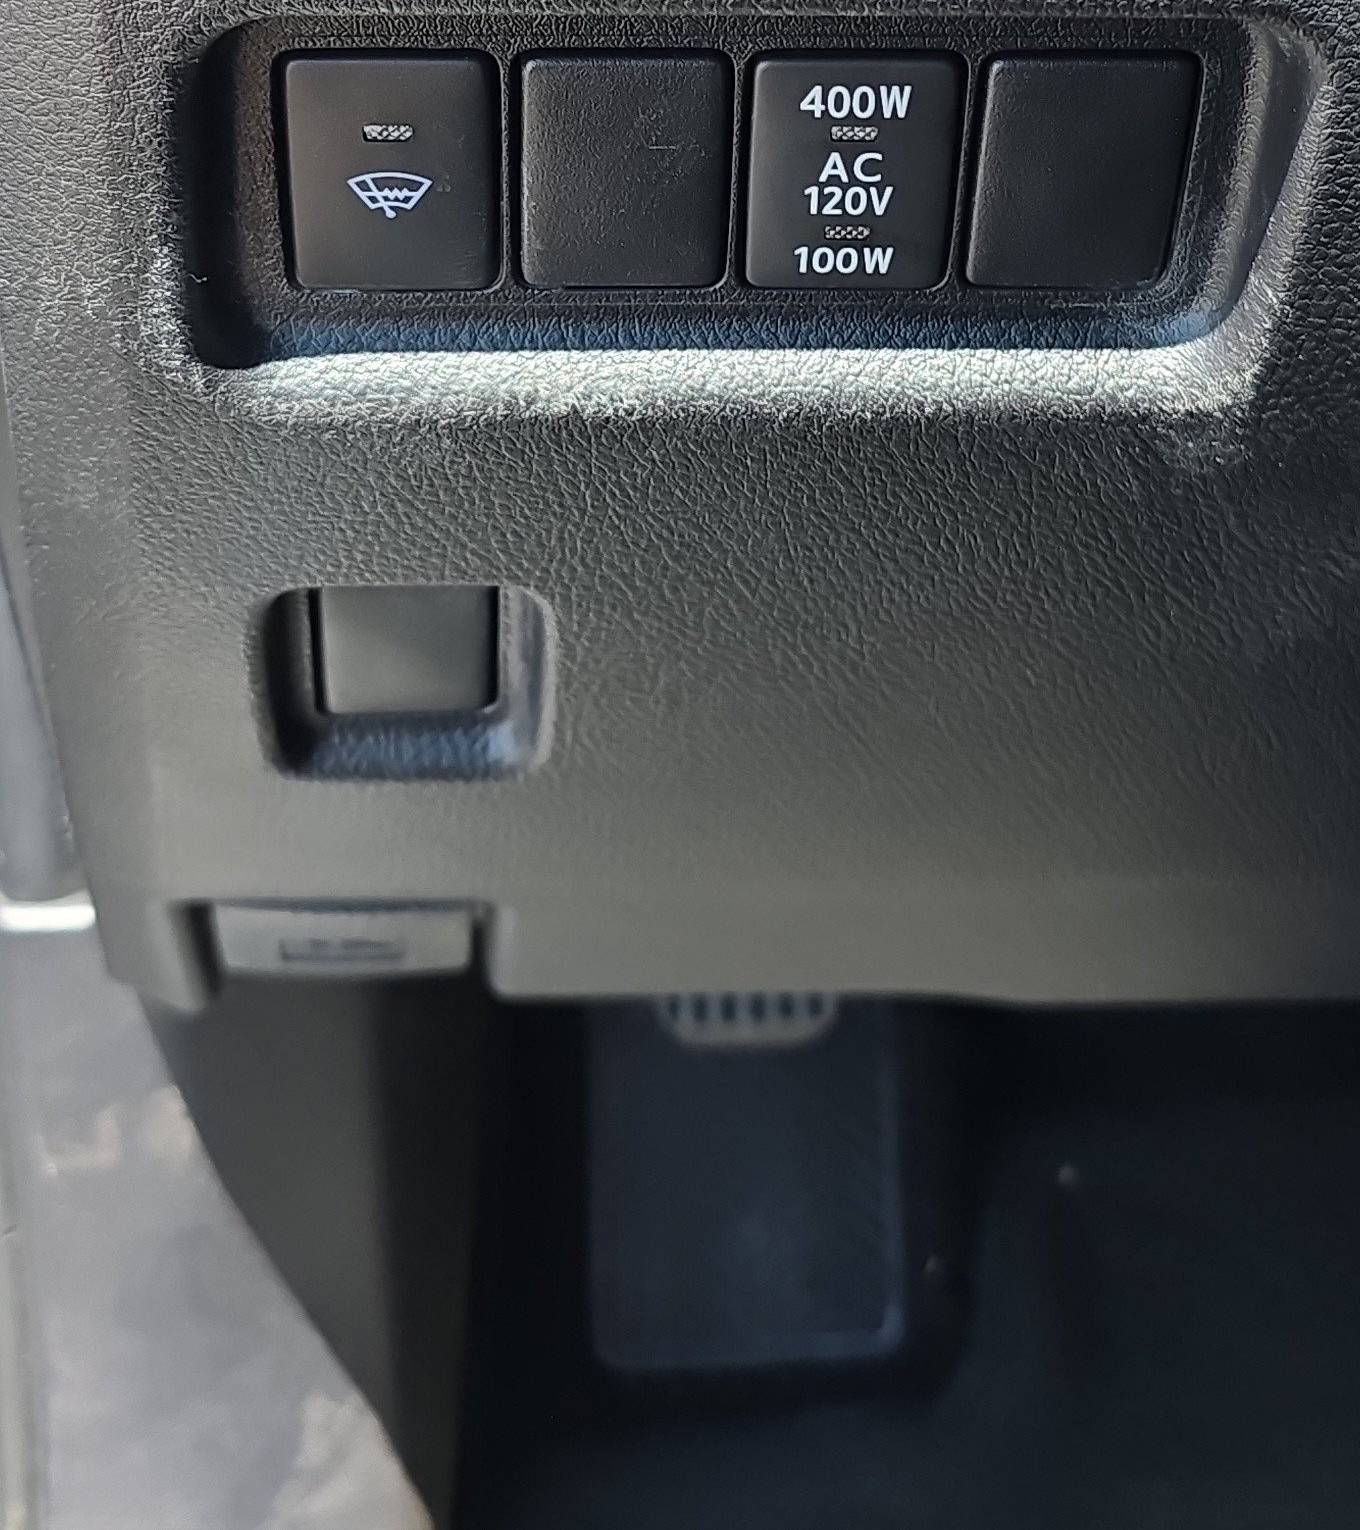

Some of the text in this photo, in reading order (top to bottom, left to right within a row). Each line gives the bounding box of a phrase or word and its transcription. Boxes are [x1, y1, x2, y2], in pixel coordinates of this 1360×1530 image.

[800, 85, 912, 119] 400W
[818, 152, 883, 184] AC
[804, 186, 893, 216] 120V
[794, 246, 893, 274] 100W
